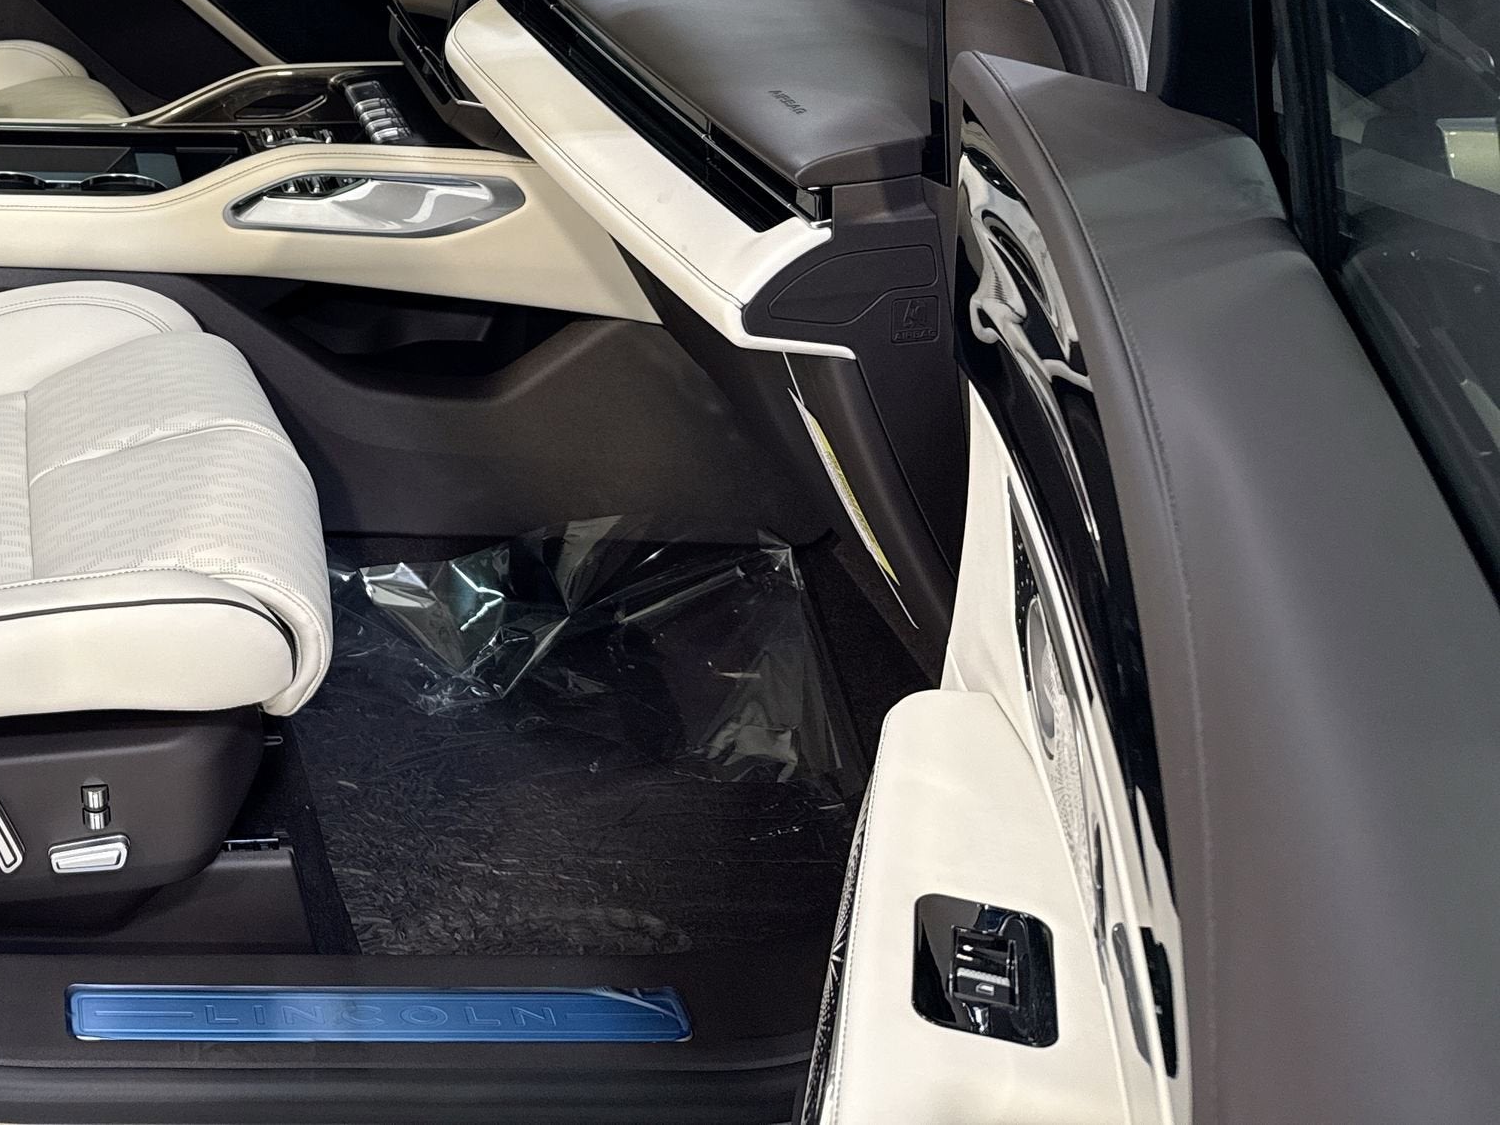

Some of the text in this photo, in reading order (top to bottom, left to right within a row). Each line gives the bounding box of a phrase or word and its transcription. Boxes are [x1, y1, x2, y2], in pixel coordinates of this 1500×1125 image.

[768, 90, 807, 114] AIRBAG
[894, 330, 936, 341] AIRBAG
[204, 1004, 557, 1026] LINCOLN
